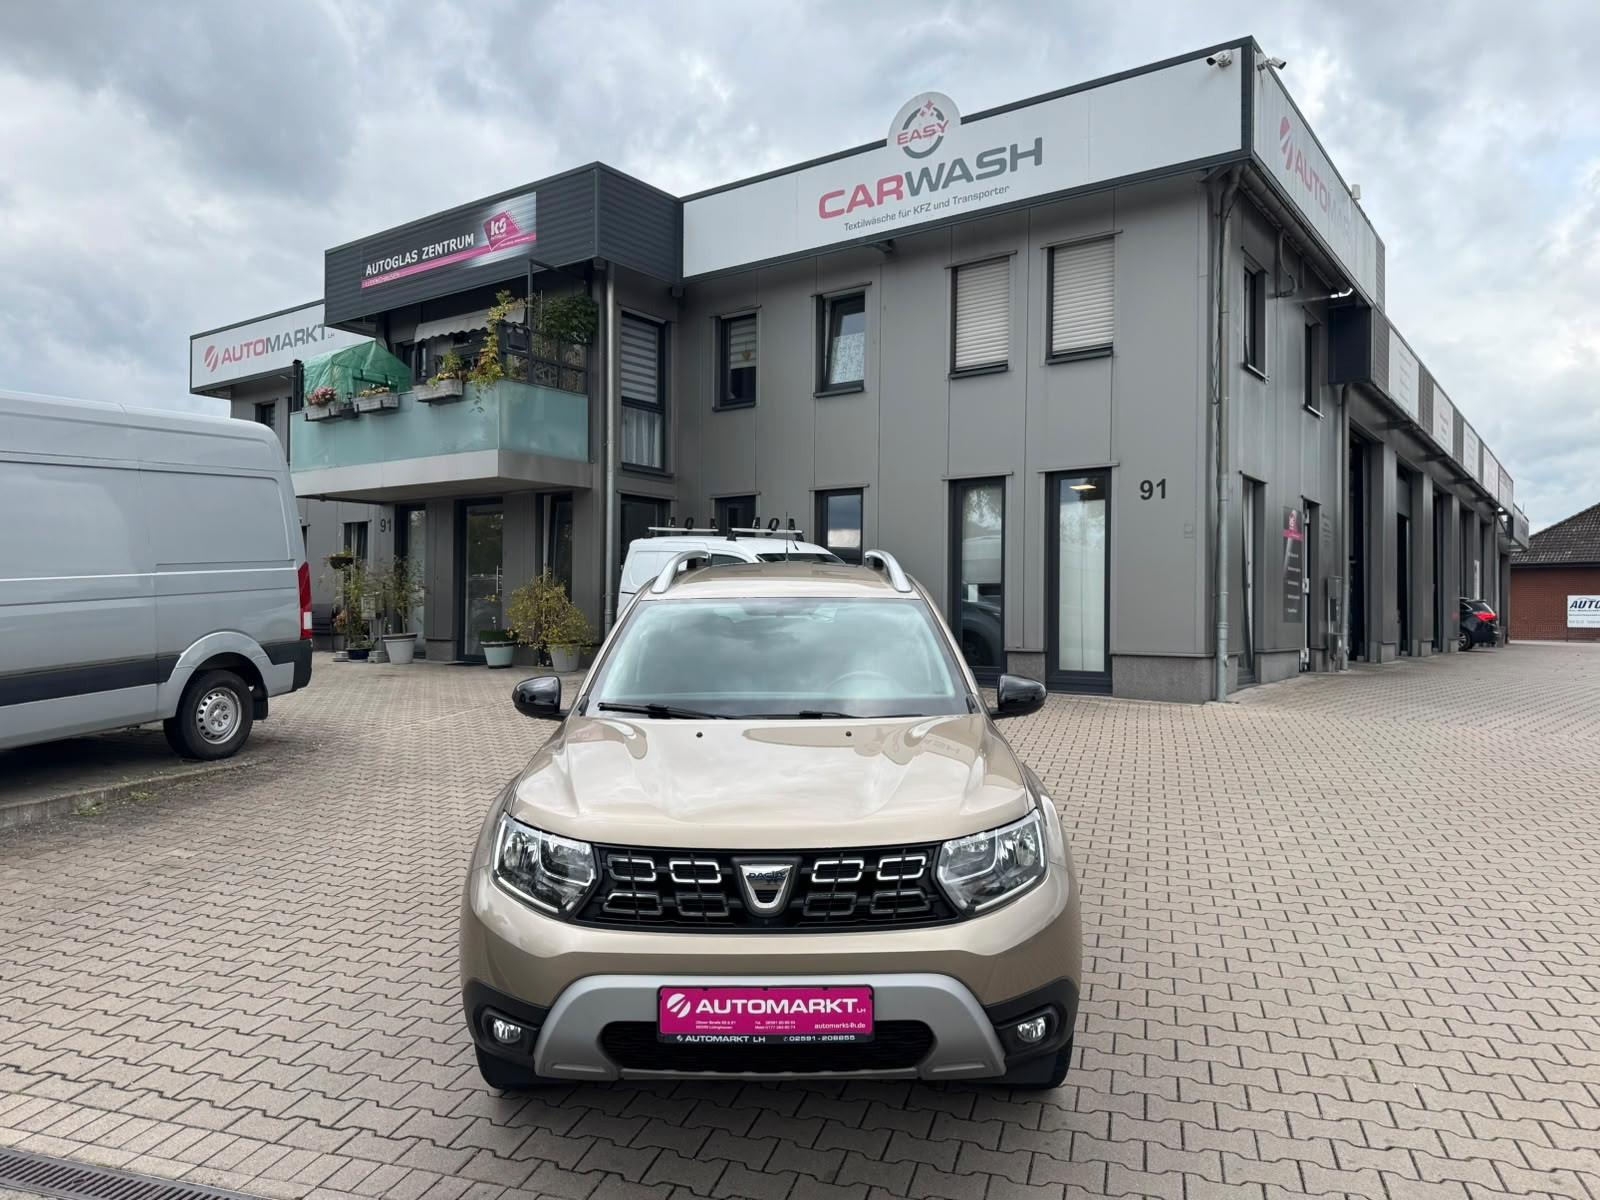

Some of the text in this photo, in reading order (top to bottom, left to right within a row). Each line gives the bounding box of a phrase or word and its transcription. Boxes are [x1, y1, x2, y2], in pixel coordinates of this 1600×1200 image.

[897, 119, 949, 146] EASY
[818, 136, 1043, 220] CARWASH
[844, 185, 1010, 231] Textilwäsche für KFZ und Transporter
[365, 233, 475, 277] AUTOGLAS ZENTRUM
[221, 323, 326, 365] AUTOMARKT
[1139, 478, 1168, 500] 91
[380, 518, 392, 533] 91
[748, 871, 785, 880] DACIA
[695, 998, 858, 1014] AUTOMARKT
[685, 1035, 750, 1043] AUTOMARKT
